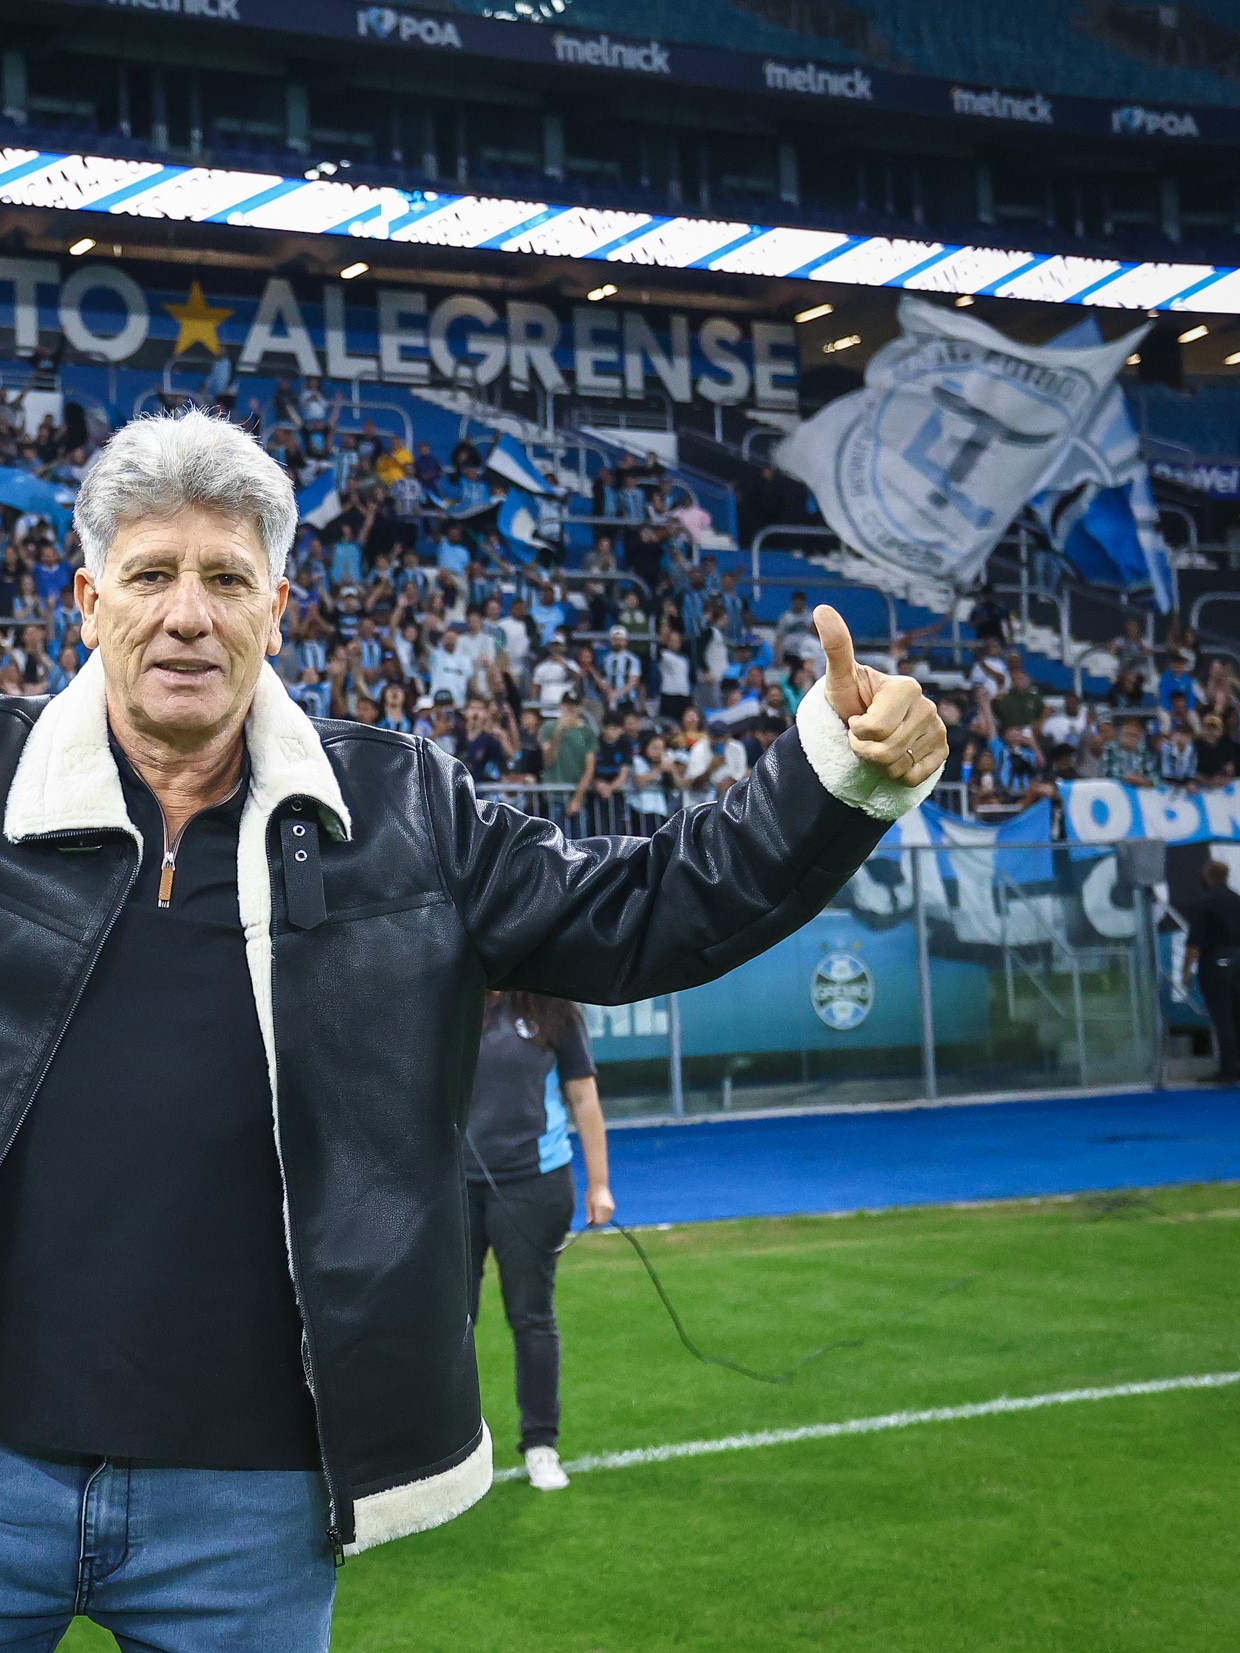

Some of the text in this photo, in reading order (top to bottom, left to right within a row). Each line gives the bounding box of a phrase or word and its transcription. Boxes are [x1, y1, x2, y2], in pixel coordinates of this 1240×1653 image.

[399, 15, 462, 48] POA
[552, 34, 671, 75] melnick
[763, 60, 872, 101] melnick
[951, 86, 1053, 124] melnick
[1143, 112, 1199, 138] POA
[237, 278, 798, 413] ALEGRENSE
